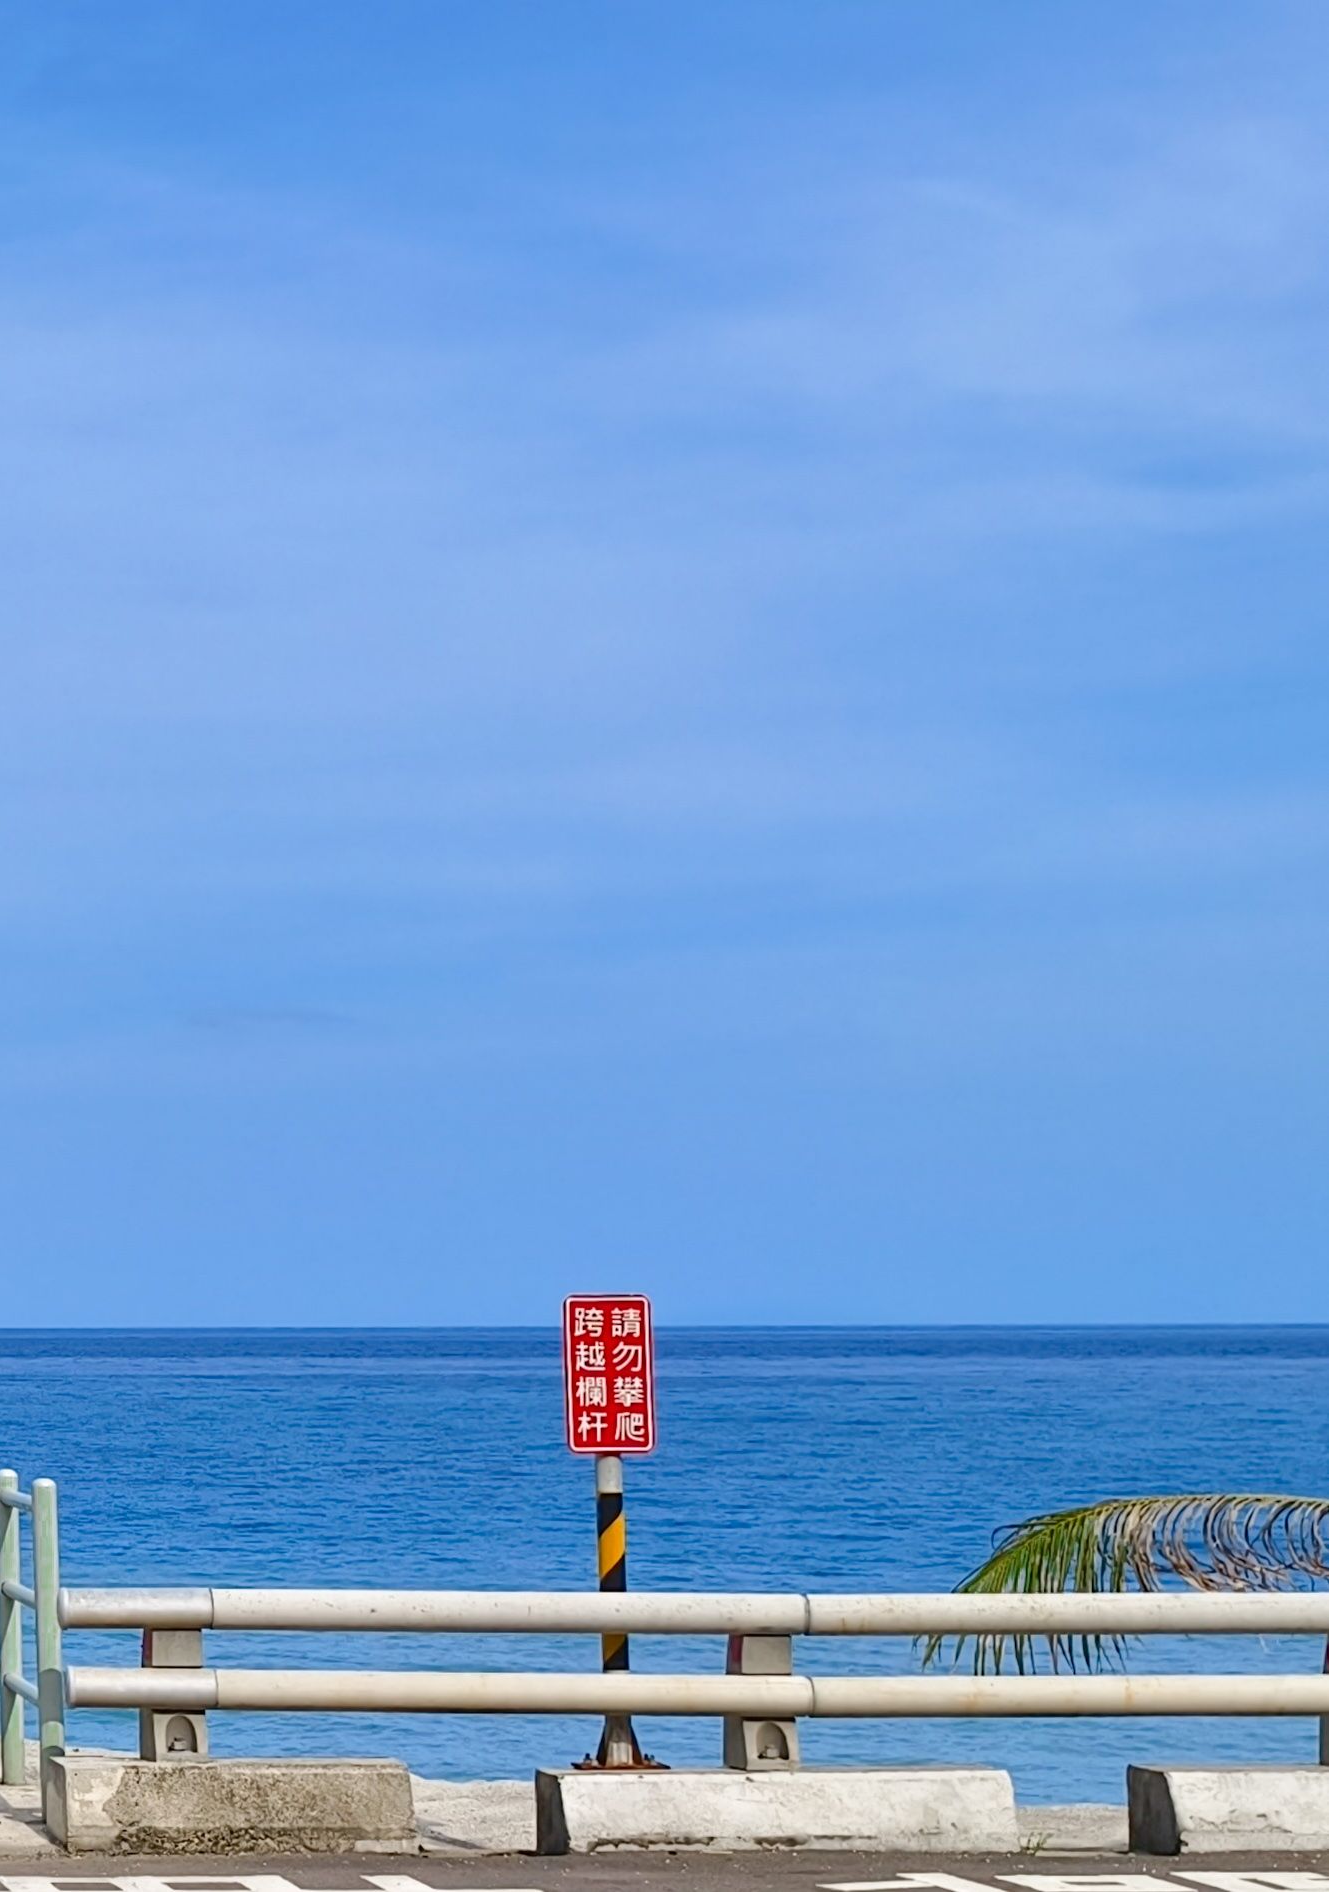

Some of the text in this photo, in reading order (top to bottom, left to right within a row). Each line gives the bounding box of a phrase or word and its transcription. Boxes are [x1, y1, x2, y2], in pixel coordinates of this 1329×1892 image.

[574, 1307, 608, 1442] 跨越欄杆
[611, 1307, 645, 1442] 請勿攀爬
